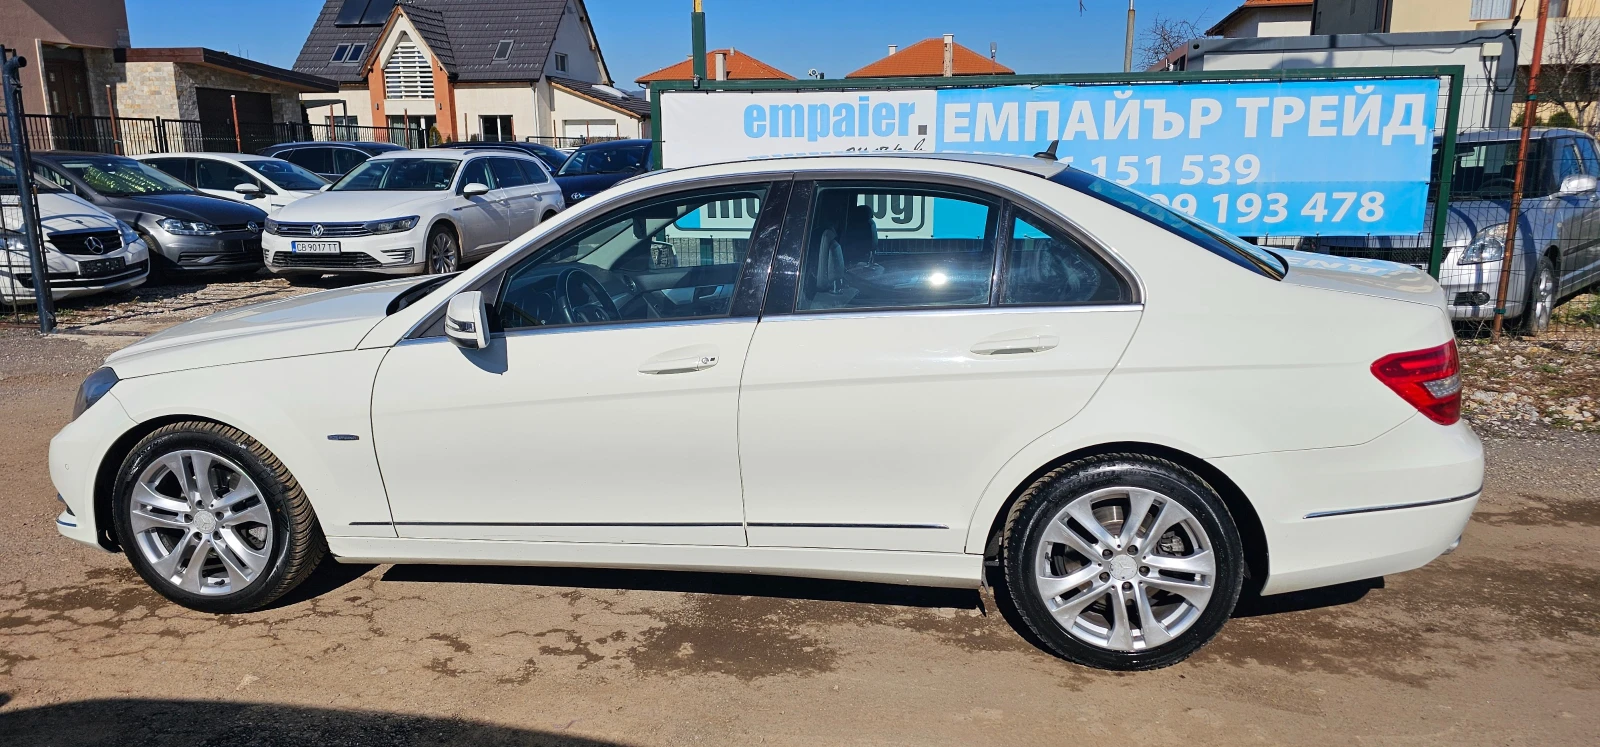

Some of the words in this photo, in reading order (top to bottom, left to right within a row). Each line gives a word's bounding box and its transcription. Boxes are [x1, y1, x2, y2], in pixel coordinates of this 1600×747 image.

[943, 90, 1223, 143] ЕМПАЙЪР
[1235, 85, 1427, 146] ТРЕЙД
[1091, 155, 1162, 187] 151
[1179, 154, 1261, 186] 539
[1212, 192, 1289, 224] 193
[1300, 191, 1385, 223] 478
[307, 243, 326, 252] 9017
[327, 243, 338, 252] TT
